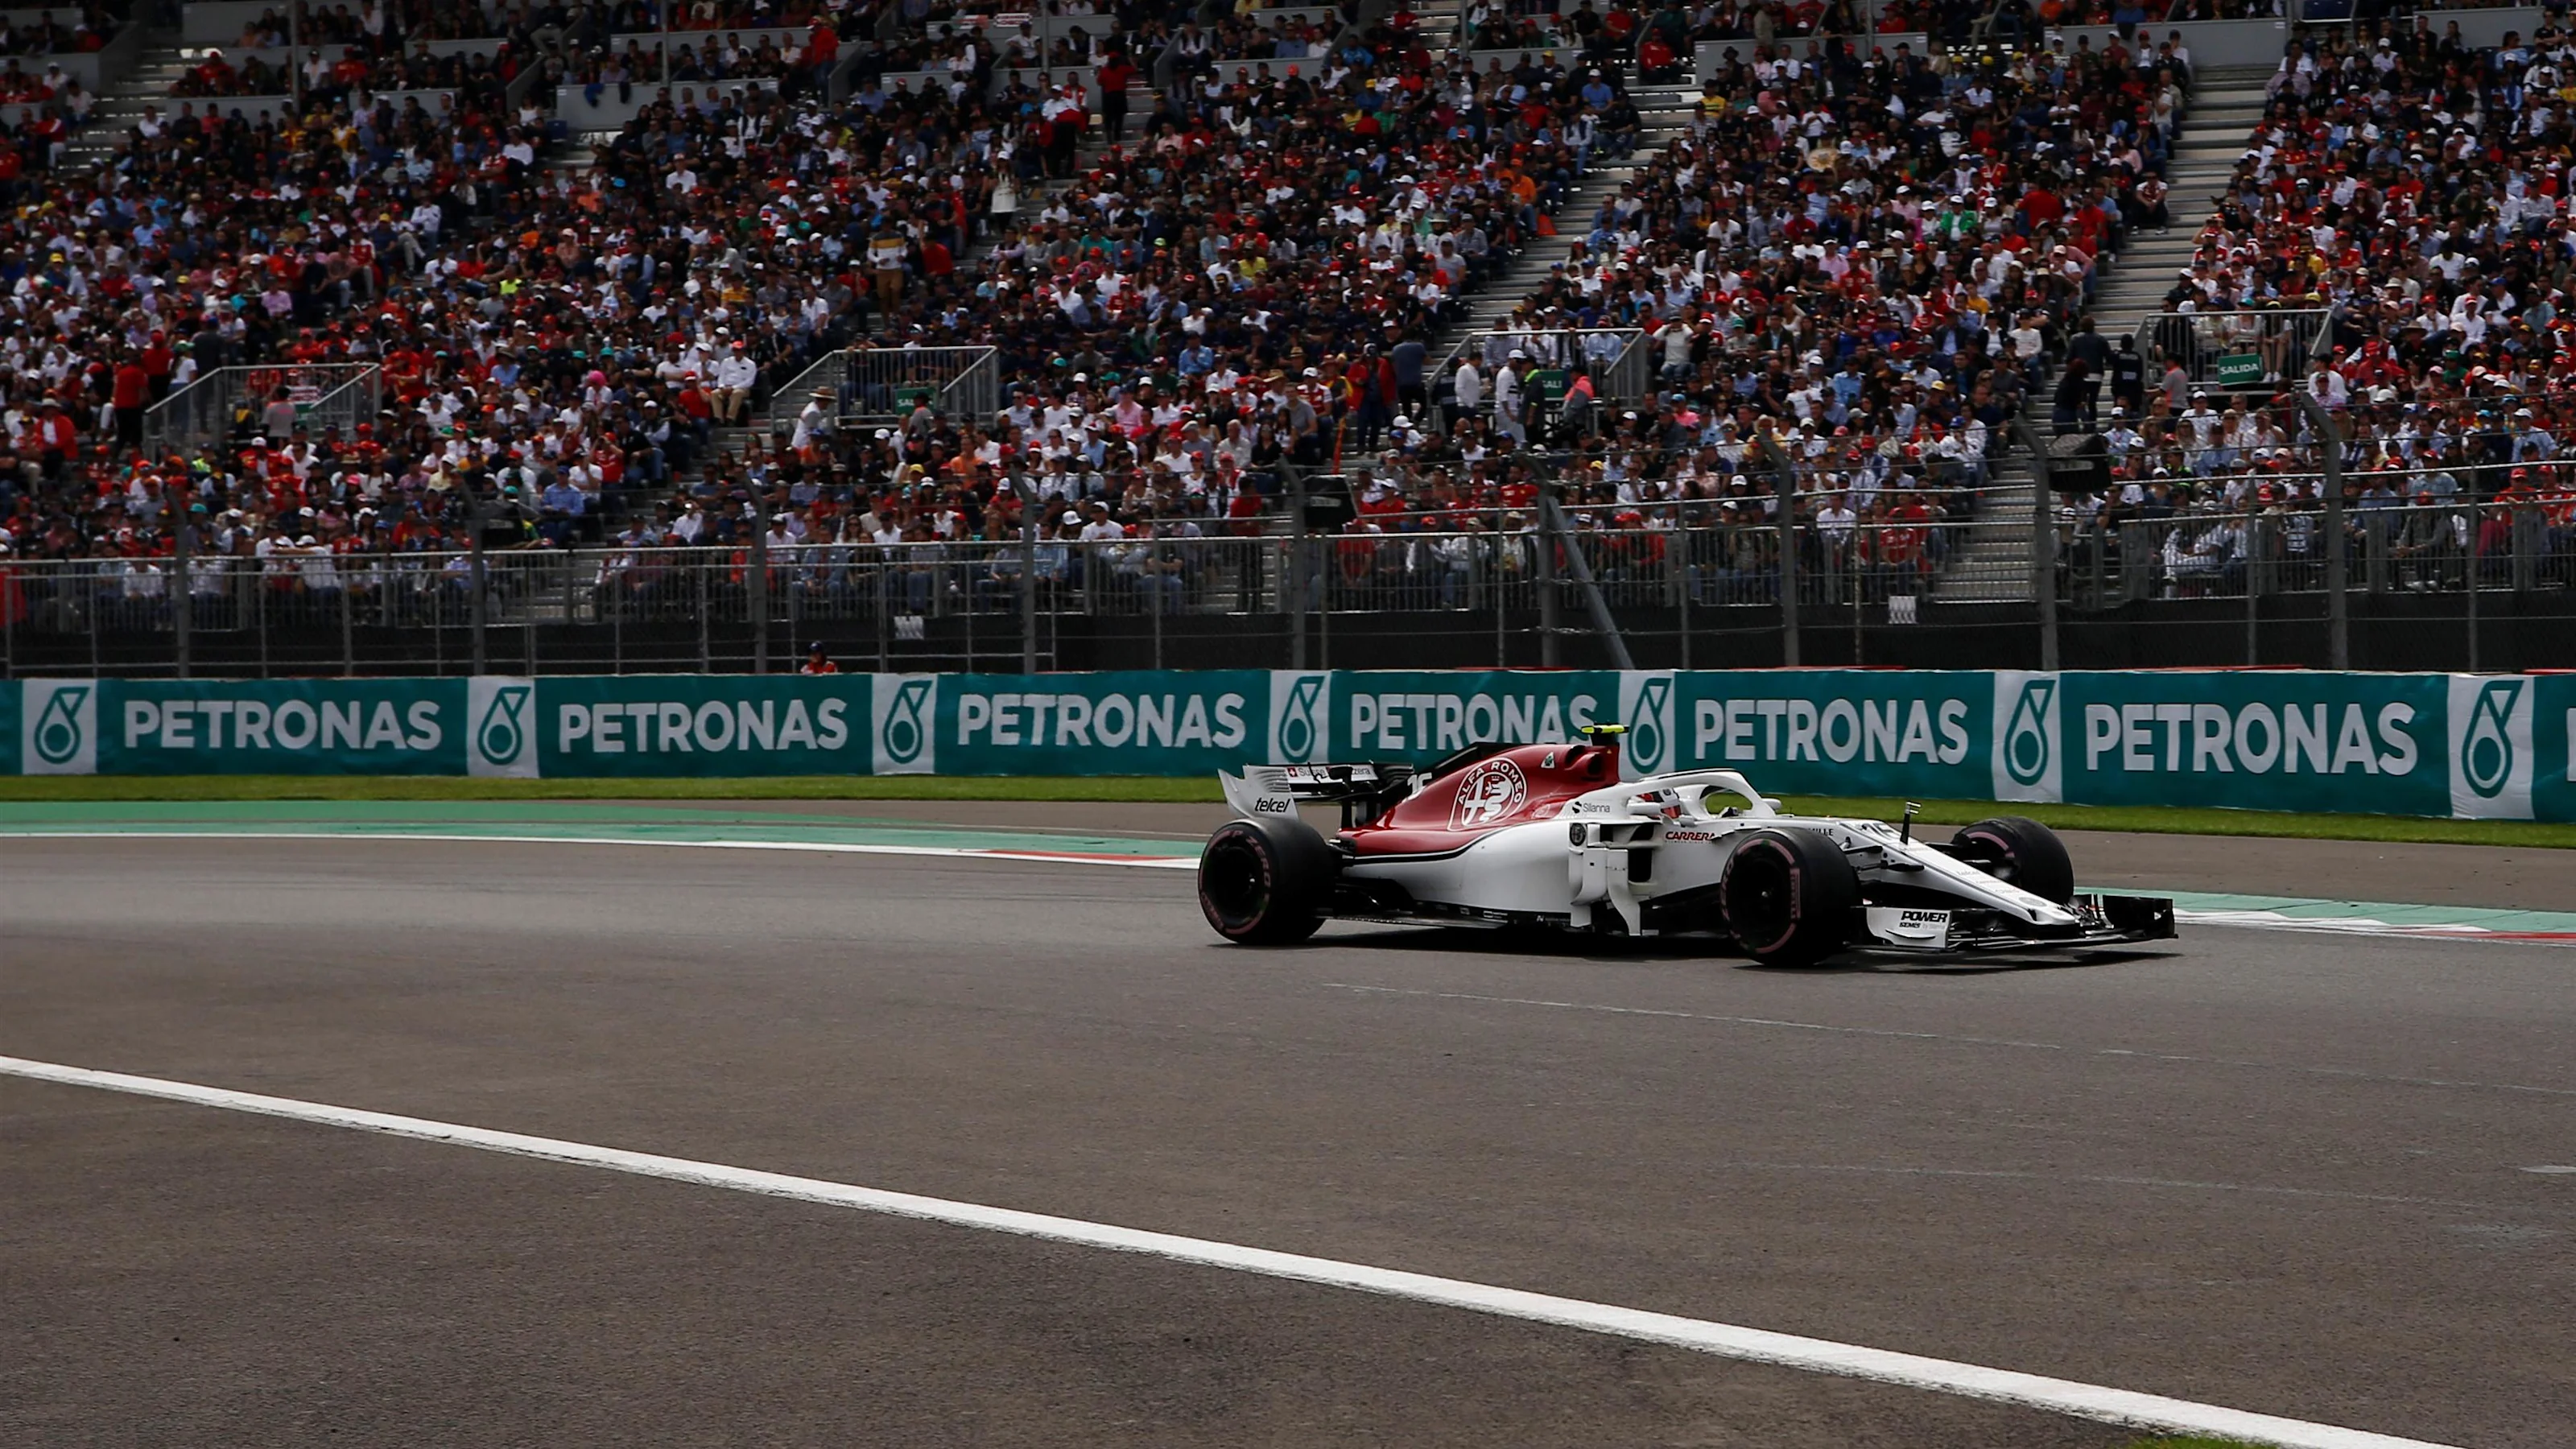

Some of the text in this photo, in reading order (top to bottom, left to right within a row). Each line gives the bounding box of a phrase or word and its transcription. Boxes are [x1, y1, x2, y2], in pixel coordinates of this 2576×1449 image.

[2219, 363, 2259, 374] SALIDA
[1542, 380, 1563, 388] SALI
[125, 700, 442, 751] PETRONAS
[559, 697, 848, 753] PETRONAS
[957, 693, 1246, 746] PETRONAS
[1351, 693, 1599, 750] PETRONAS
[1695, 699, 1969, 764] PETRONAS
[2085, 702, 2417, 775] PETRONAS
[1298, 766, 1327, 776] Susse
[1458, 762, 1523, 805] ALFA ROMEO
[1254, 797, 1290, 813] telcel
[1583, 803, 1610, 813] Silanna
[1666, 832, 1715, 840] CARRERA
[1901, 910, 1948, 923] POWER
